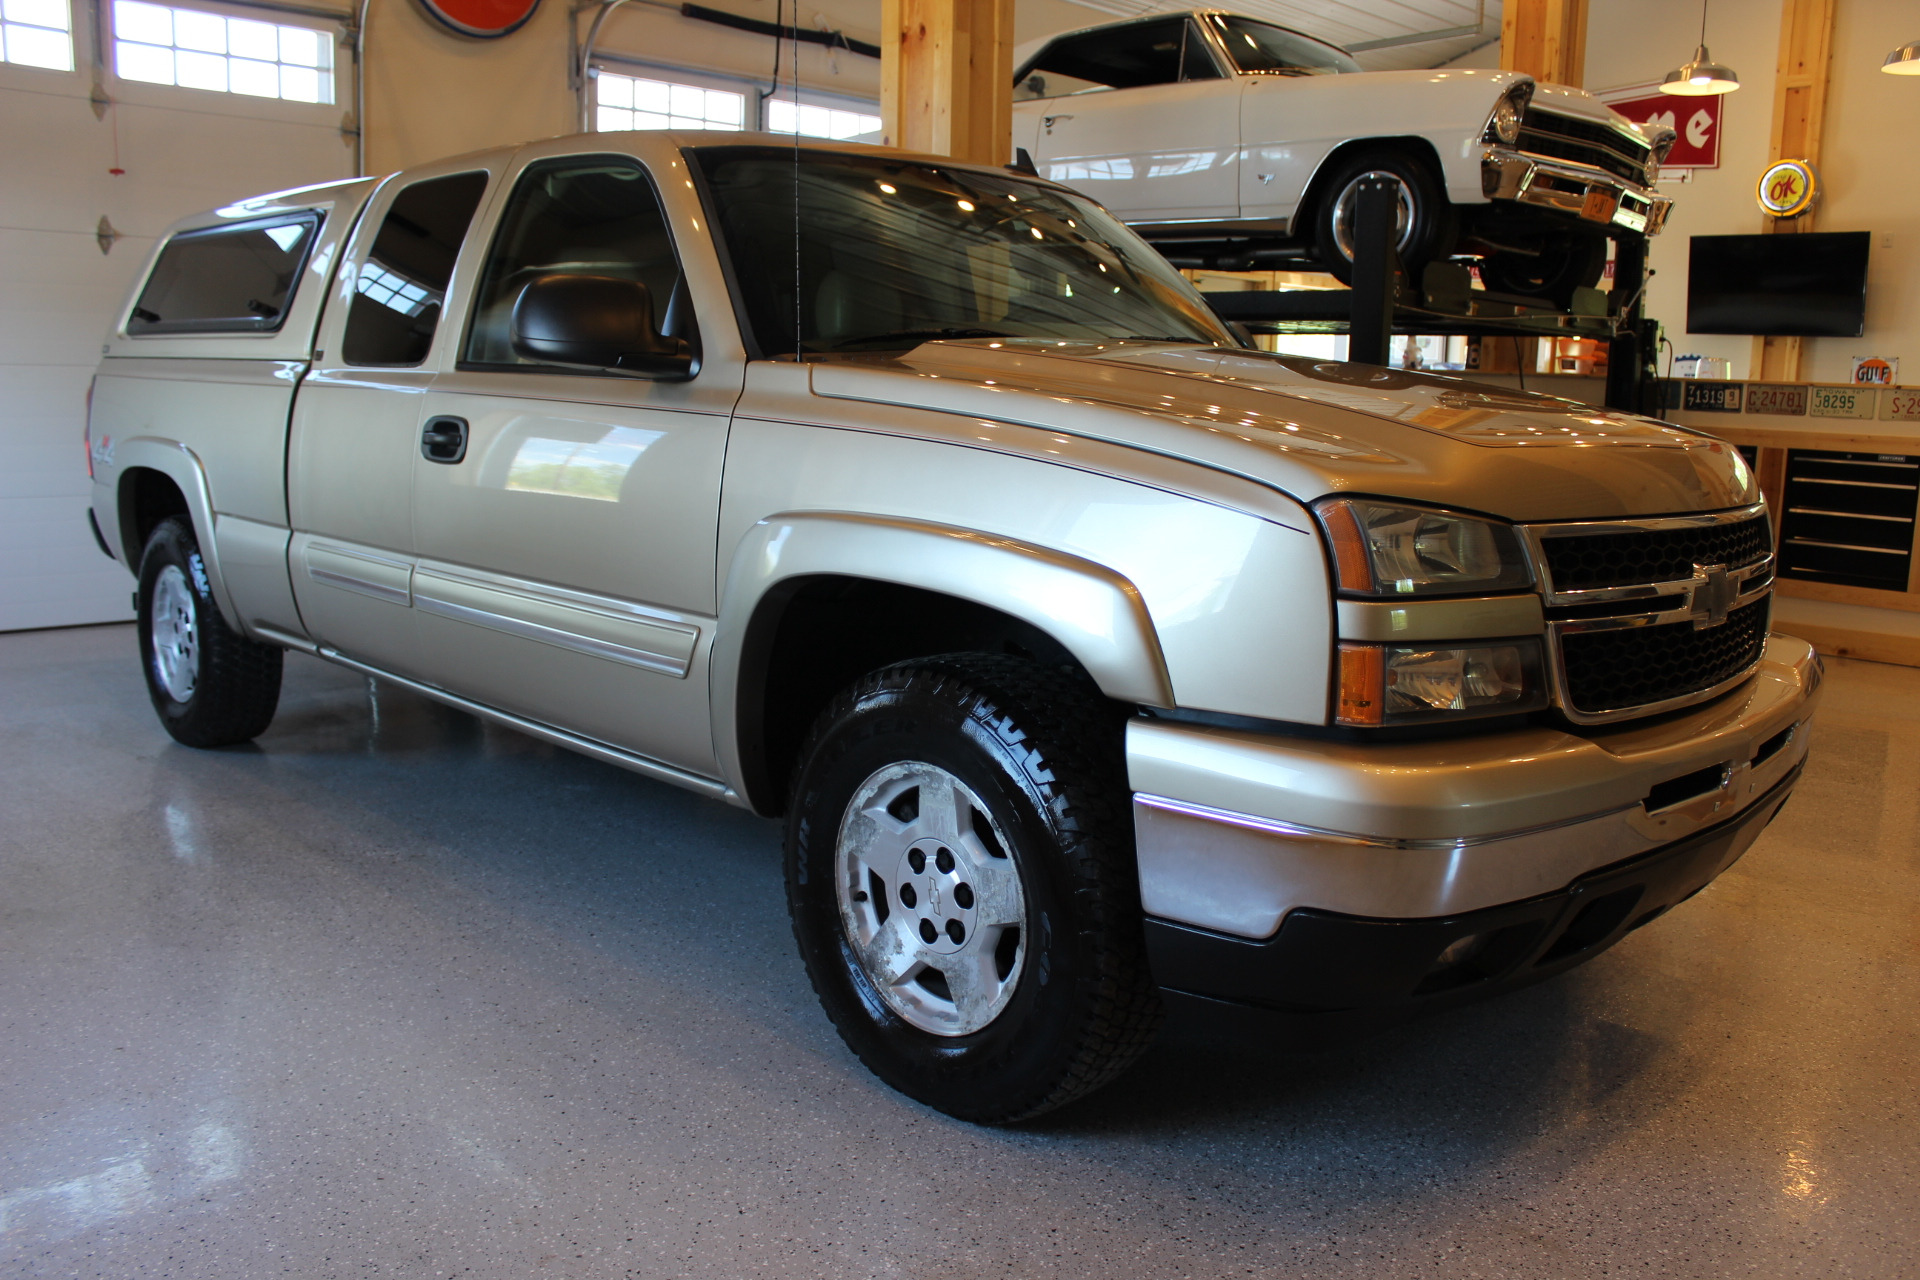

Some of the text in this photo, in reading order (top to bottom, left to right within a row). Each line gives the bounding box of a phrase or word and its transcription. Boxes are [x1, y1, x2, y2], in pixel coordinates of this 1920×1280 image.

[1771, 175, 1797, 201] OK
[1856, 365, 1890, 383] GULF
[1695, 389, 1724, 404] 1319
[1823, 394, 1855, 409] 8295
